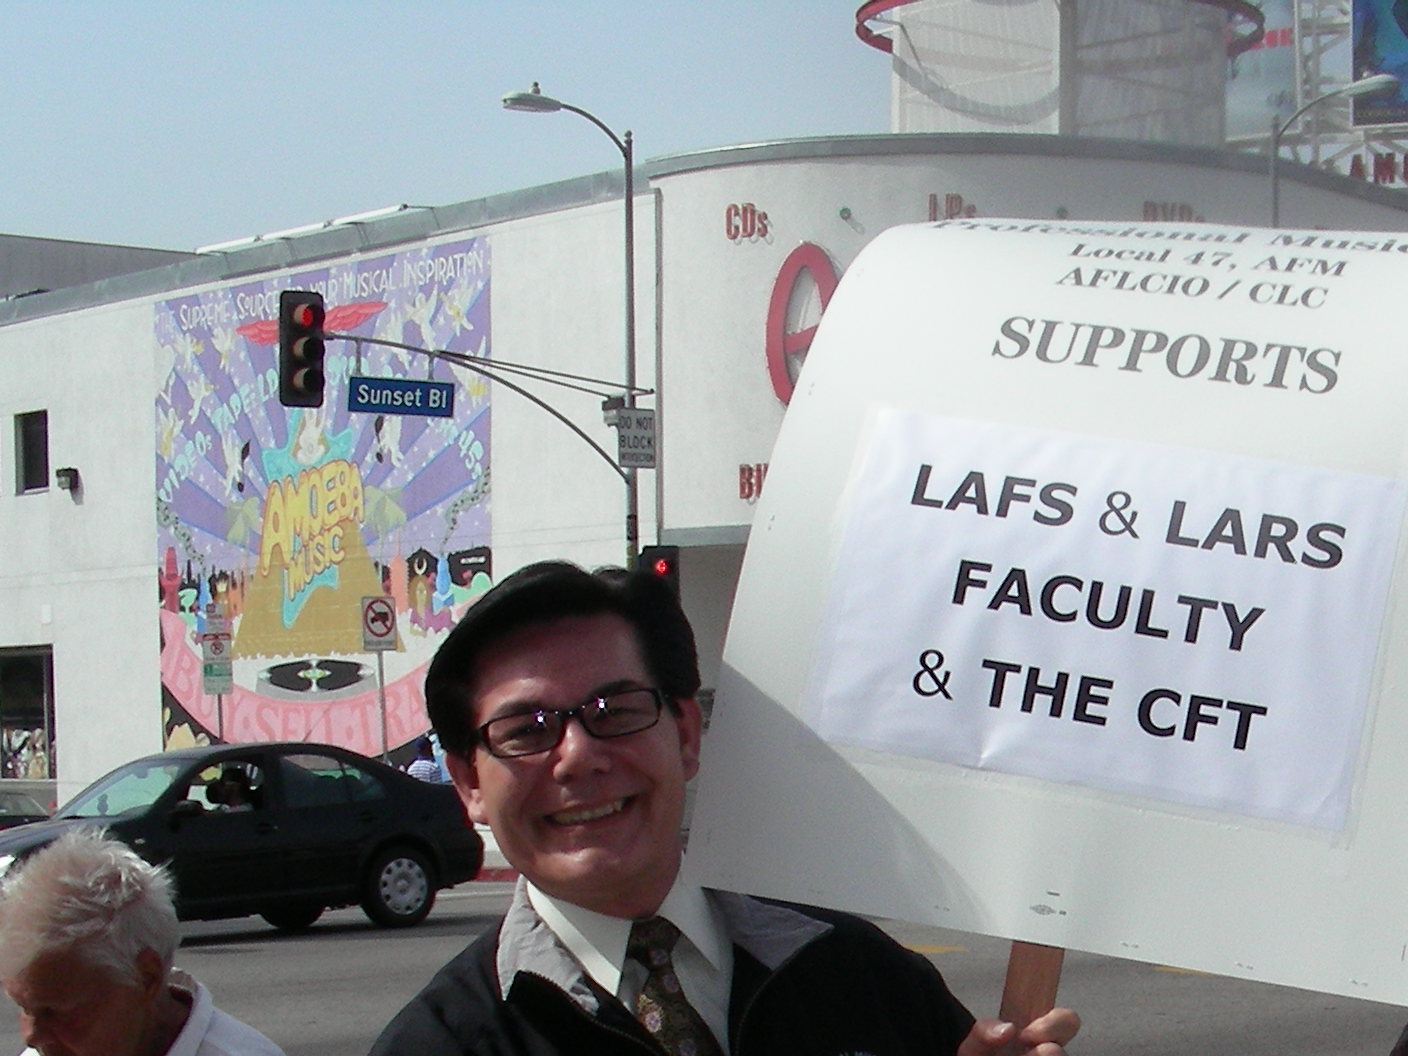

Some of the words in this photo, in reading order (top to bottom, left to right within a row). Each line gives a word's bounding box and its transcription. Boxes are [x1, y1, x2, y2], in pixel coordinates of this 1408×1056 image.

[725, 203, 769, 240] CDs
[931, 221, 1252, 244] Professional
[179, 299, 232, 332] SUPREME
[343, 266, 397, 299] MUSICAL
[400, 249, 485, 288] INSPIRATION
[1055, 266, 1211, 298] AFLCIO
[1249, 282, 1330, 309] CLC
[1069, 243, 1172, 264] Local
[1182, 250, 1239, 271] 47,
[1253, 255, 1351, 277] AFM
[991, 315, 1343, 395] SUPPORTS
[357, 384, 423, 407] Sunset
[429, 388, 448, 409] Bl
[636, 417, 653, 430] NOT
[619, 434, 652, 449] BLOCK
[260, 459, 365, 578] AMOEBA
[910, 464, 1078, 527] LAFS
[1098, 490, 1140, 539] &
[1165, 500, 1347, 569] LARS
[287, 524, 346, 601] MUSIC
[951, 559, 1266, 652] FACULTY
[350, 680, 427, 752] TRA
[912, 649, 953, 700] &
[981, 658, 1114, 726] THE
[1136, 688, 1268, 751] CFT
